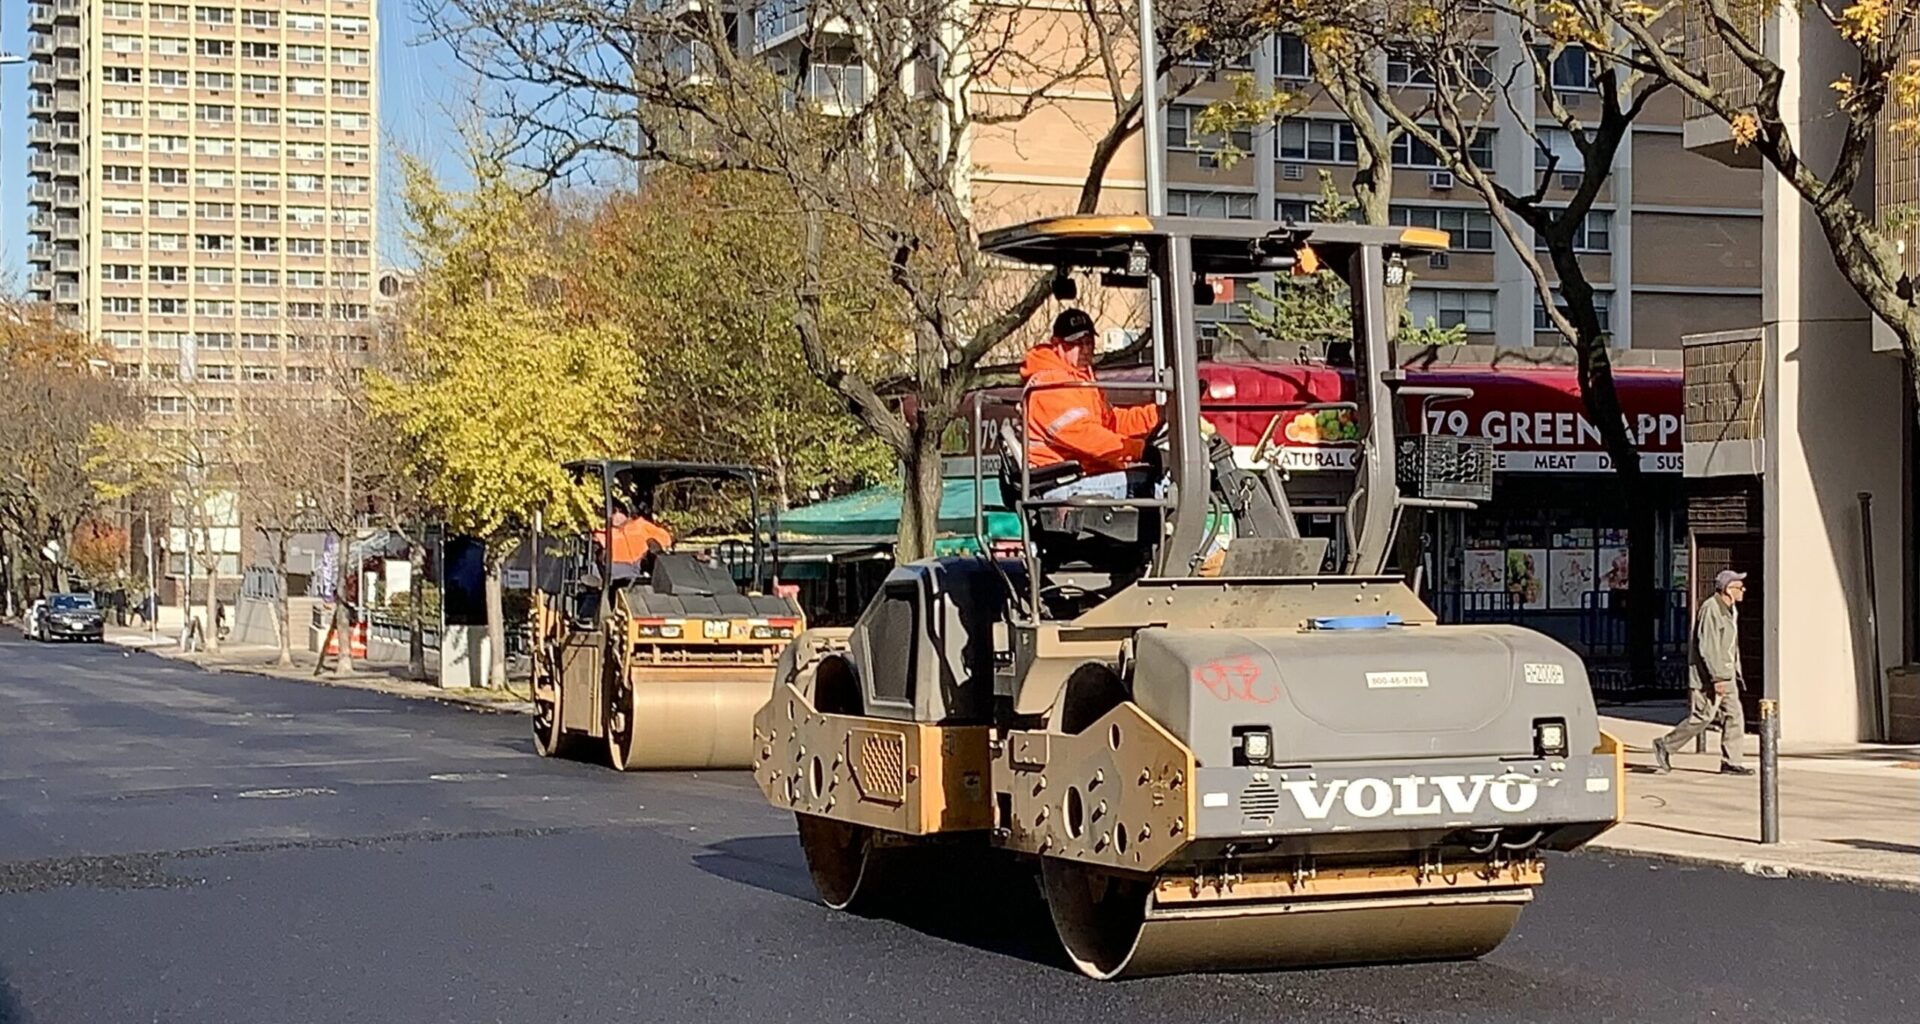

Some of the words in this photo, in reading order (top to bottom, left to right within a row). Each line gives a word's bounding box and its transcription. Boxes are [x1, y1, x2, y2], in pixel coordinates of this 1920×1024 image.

[981, 418, 998, 450] 79
[1427, 410, 1469, 436] 79
[1481, 410, 1602, 445] GREEN
[1534, 455, 1577, 471] MEAT
[704, 620, 730, 638] CAT
[1281, 773, 1538, 819] VOLVO
